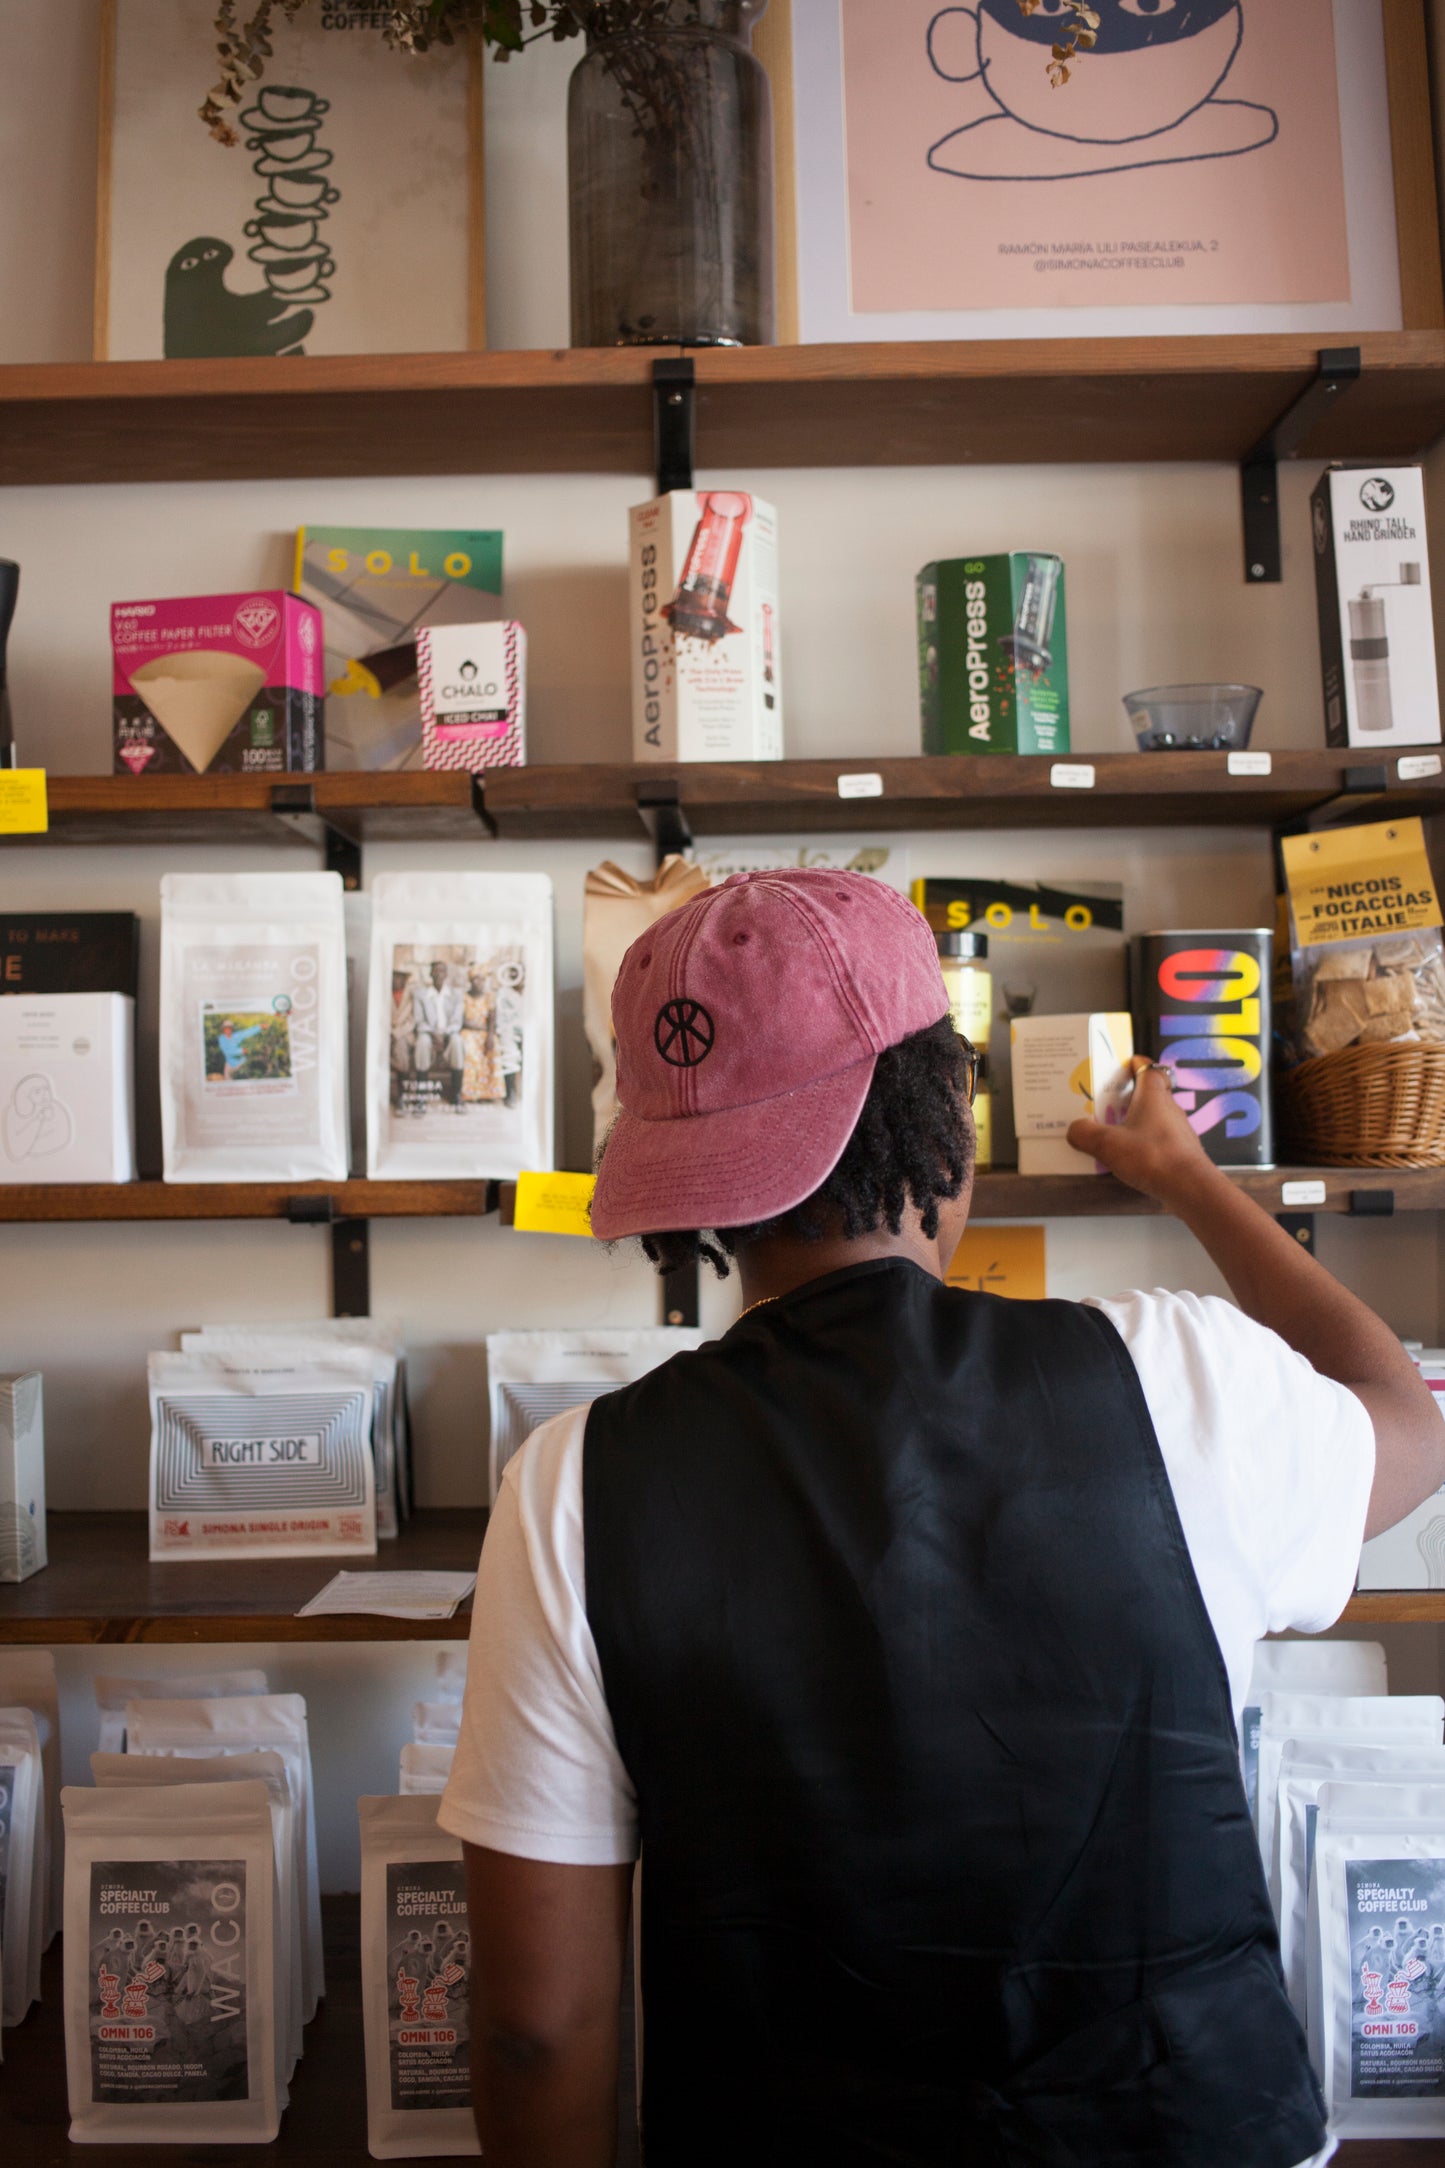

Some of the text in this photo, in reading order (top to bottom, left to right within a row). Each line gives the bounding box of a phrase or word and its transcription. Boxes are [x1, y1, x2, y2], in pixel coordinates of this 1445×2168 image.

[1210, 241, 1219, 251] 2
[1344, 528, 1416, 542] HAND GRINDER
[327, 549, 472, 578] SOLO
[964, 562, 985, 574] GO
[115, 624, 232, 644] COFFEE PAPER FILTER
[641, 544, 661, 747] AeroPress
[966, 581, 991, 741] AeroPress
[441, 683, 498, 699] CHALO
[1327, 876, 1402, 899] NICOIS
[1313, 890, 1432, 918] FOCACCIAS
[947, 901, 1093, 932] SOLO
[1341, 912, 1407, 932] ITALIE
[290, 955, 317, 1075] WACO
[1158, 949, 1262, 1139] SOLO
[212, 1439, 308, 1464] RIGHT SIDE
[202, 1522, 246, 1535] SIMONA
[250, 1521, 287, 1533] SINGLE
[290, 1520, 329, 1532] ORIGIN
[100, 1890, 157, 1902] SPECIALTY
[397, 1890, 455, 1904] SPECIALTY
[1357, 1888, 1415, 1900] SPECIALTY
[100, 1902, 170, 1914] COFFEE CLUB
[397, 1902, 467, 1916] COFFEE CLUB
[1358, 1899, 1428, 1913] COFFEE CLUB
[210, 1883, 240, 2022] WACO
[101, 2027, 153, 2039] OMNI 106
[1364, 2023, 1416, 2035] OMNI 106
[401, 2031, 454, 2043] OMNI 106
